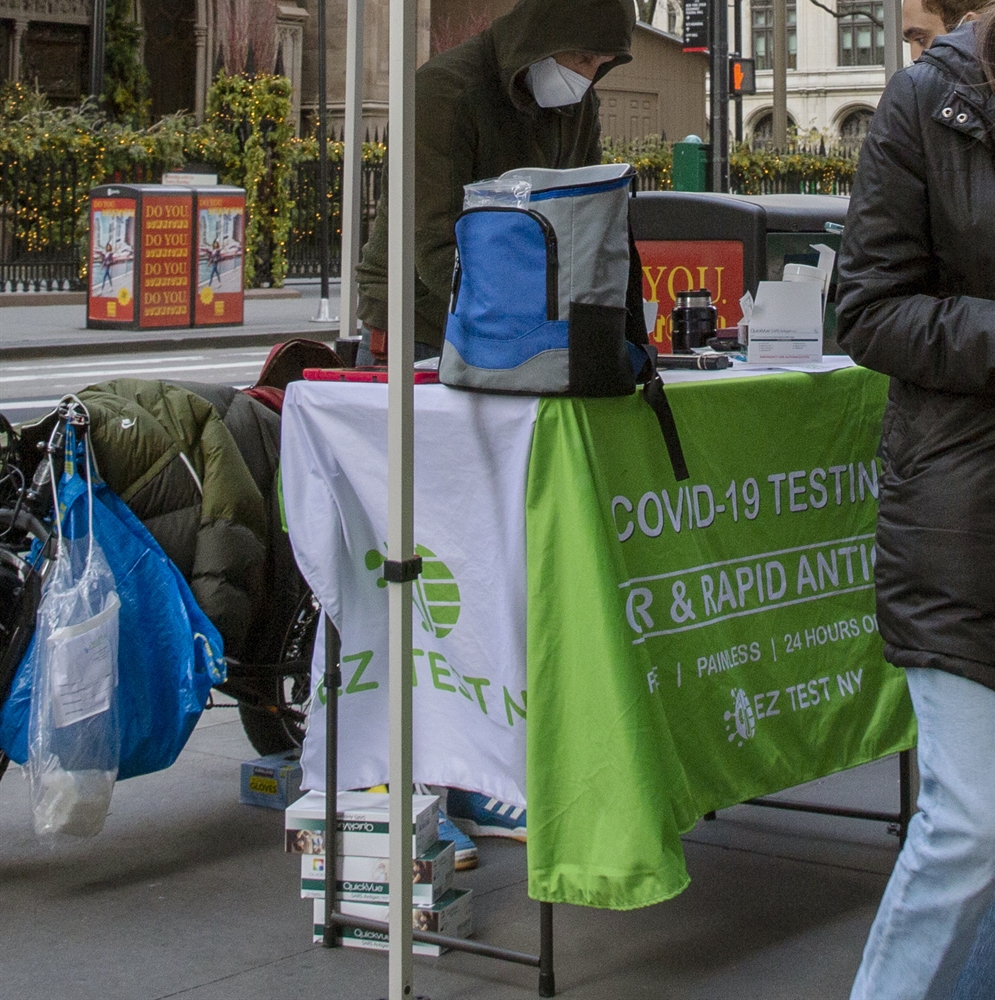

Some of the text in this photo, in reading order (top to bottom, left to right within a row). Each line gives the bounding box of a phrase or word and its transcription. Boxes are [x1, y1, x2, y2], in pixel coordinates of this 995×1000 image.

[146, 205, 163, 218] DO
[145, 234, 162, 246] DO
[145, 262, 162, 275] DO
[144, 291, 161, 305] DO
[611, 477, 760, 542] COVID-19
[670, 580, 696, 623] &
[701, 560, 787, 617] RAPID
[797, 543, 877, 596] ANTI
[697, 641, 761, 678] PAINLESS
[784, 632, 802, 654] 24
[805, 618, 861, 649] HOURS
[754, 668, 863, 721] EZ TEST NY
[342, 881, 384, 893] QuickVue
